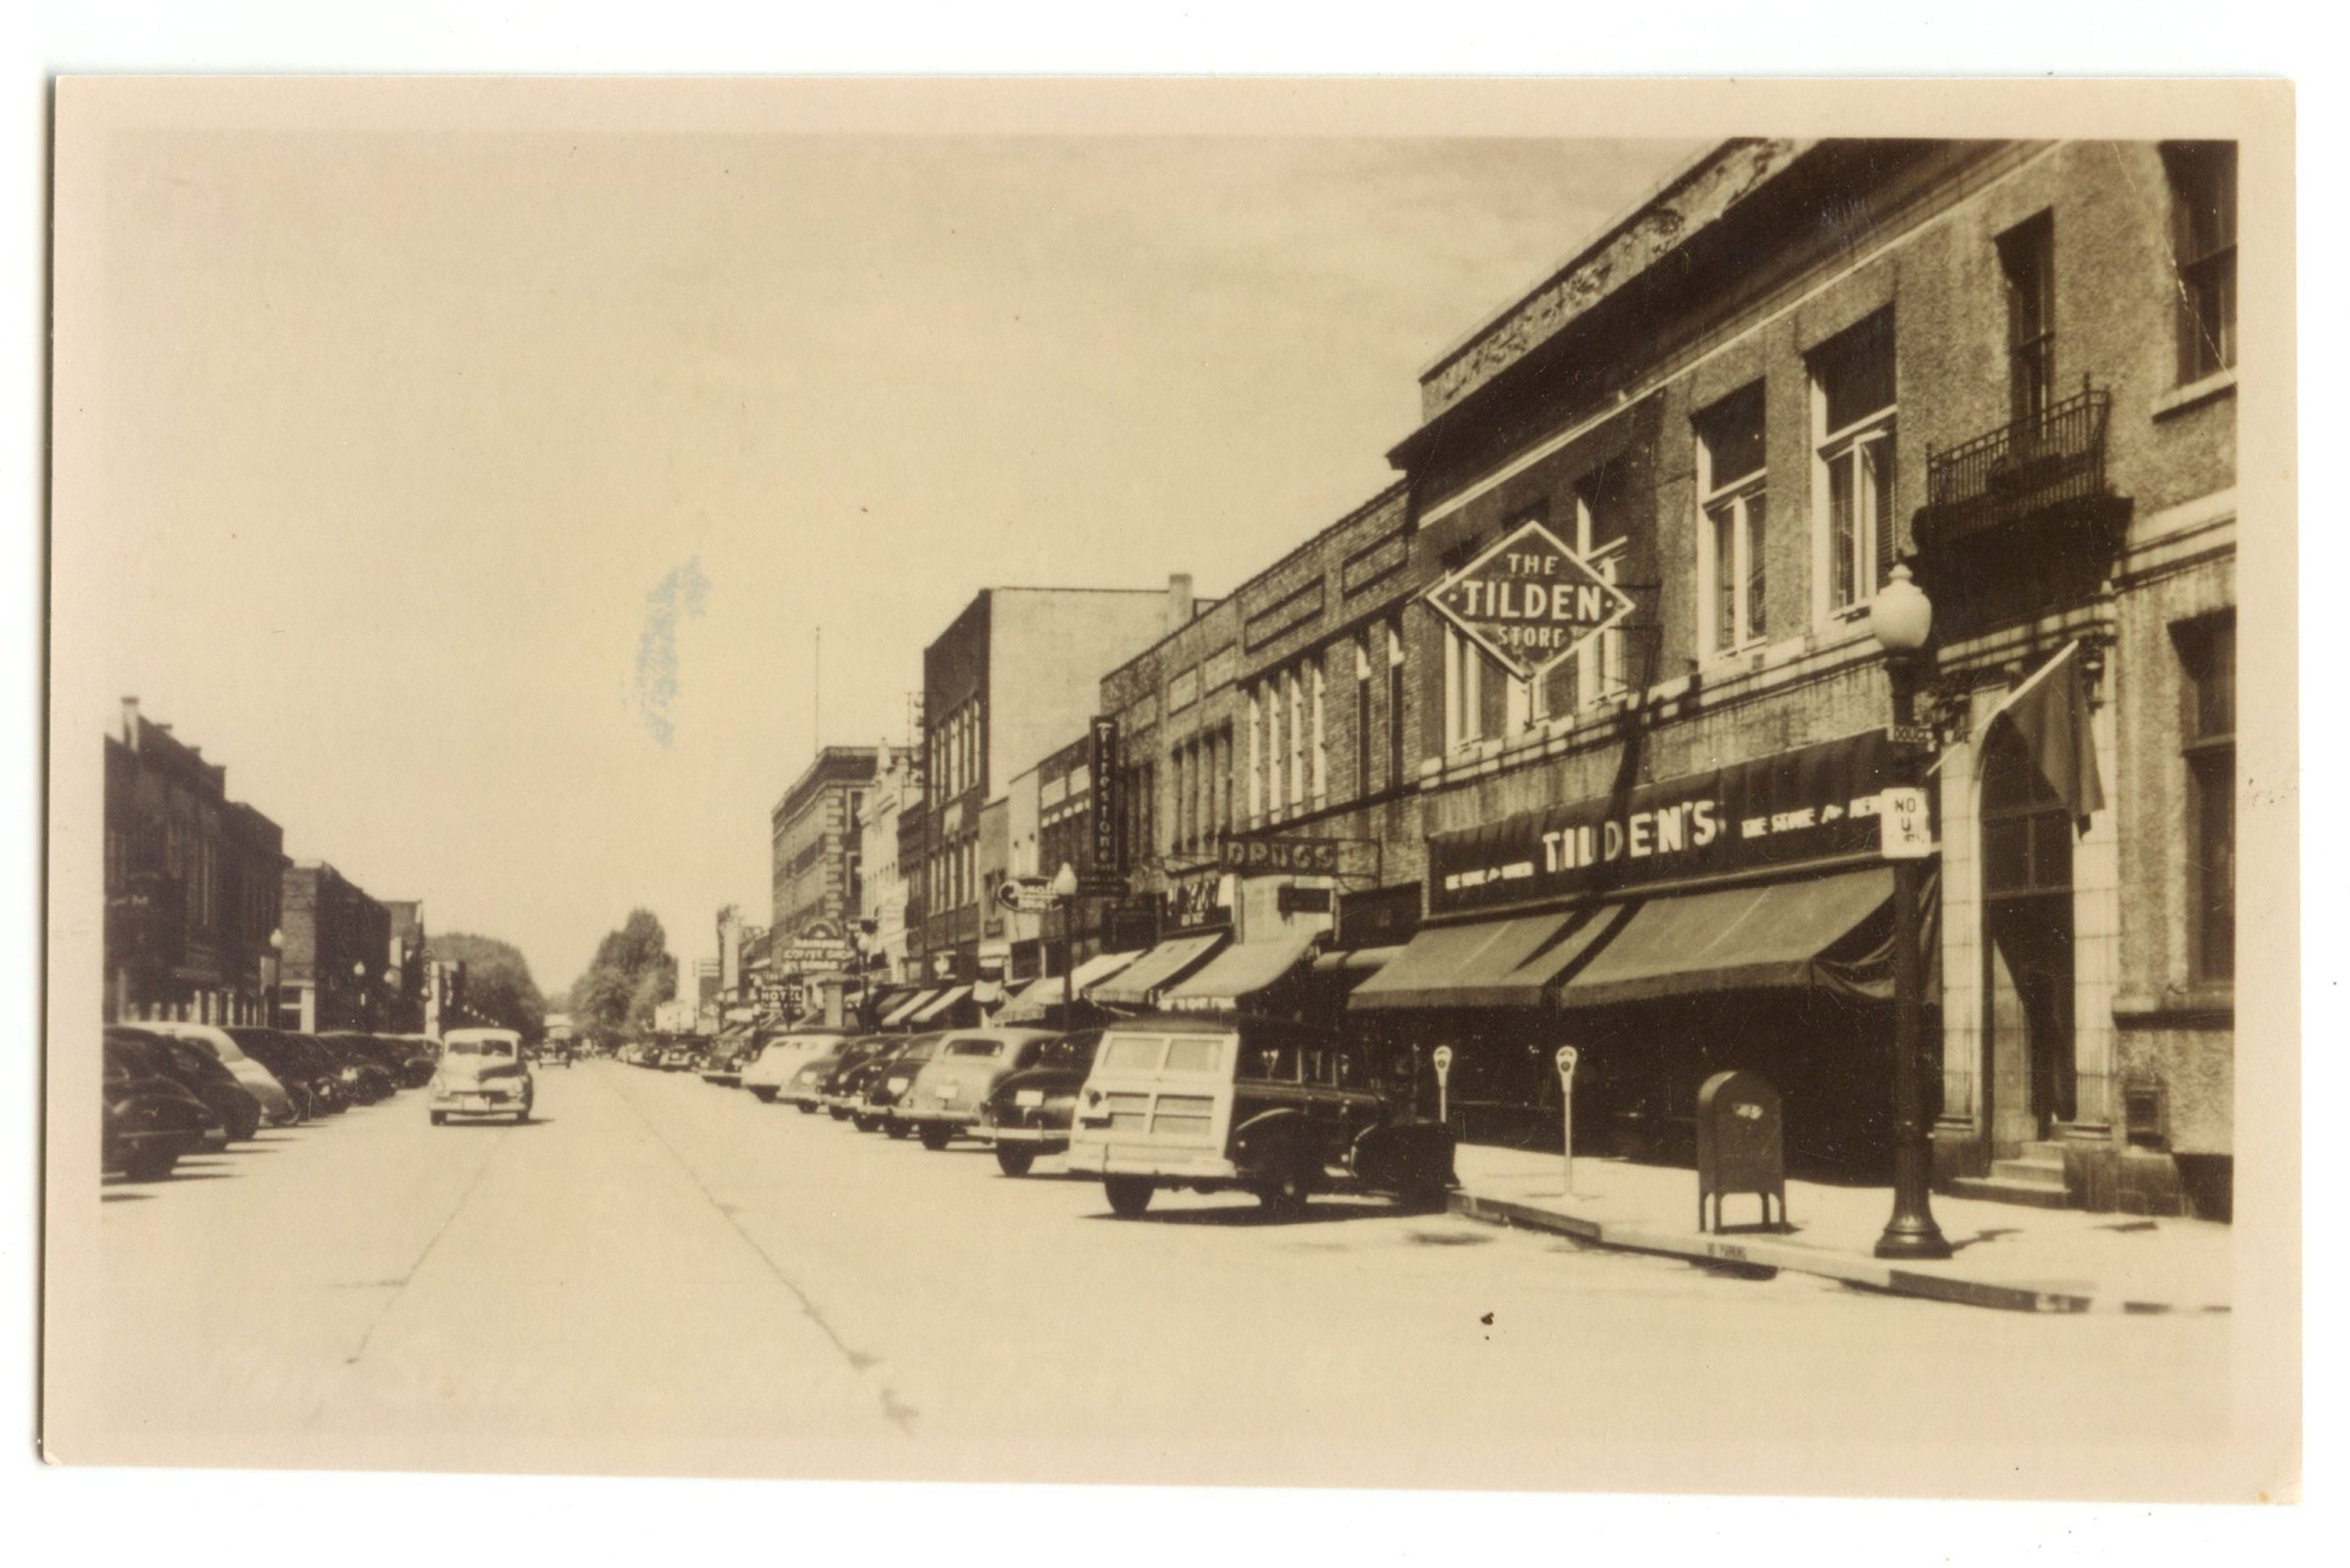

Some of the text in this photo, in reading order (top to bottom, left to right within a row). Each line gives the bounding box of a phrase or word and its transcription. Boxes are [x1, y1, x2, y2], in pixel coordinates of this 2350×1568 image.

[1506, 553, 1560, 575] THE
[1462, 580, 1601, 622] TILDEN
[1498, 627, 1565, 648] STORE
[1895, 797, 1917, 813] NO
[1542, 800, 1716, 873] TILDEN'S
[1227, 840, 1333, 869] DRUGS
